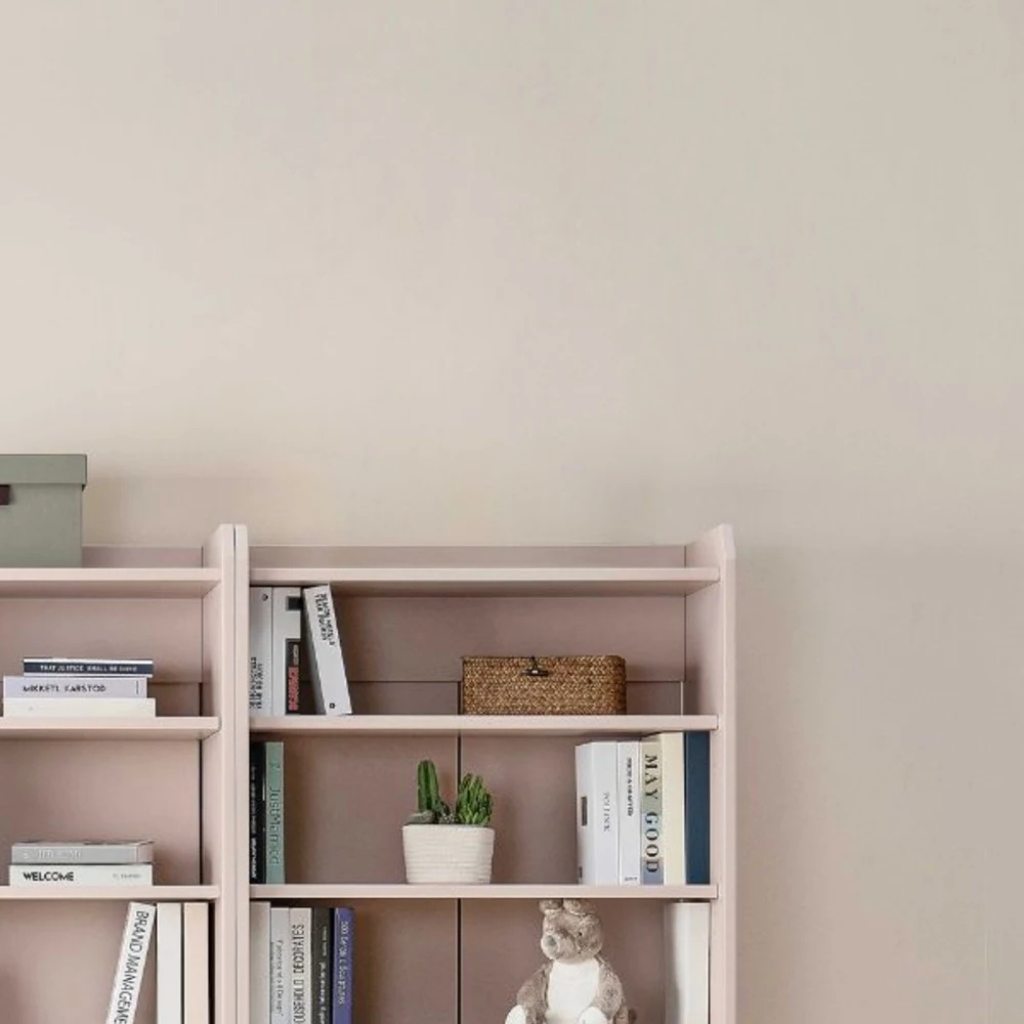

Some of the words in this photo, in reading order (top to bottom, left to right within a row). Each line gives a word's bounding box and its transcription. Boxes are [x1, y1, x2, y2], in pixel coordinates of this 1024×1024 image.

[644, 754, 658, 800] MAY
[644, 812, 659, 873] GOOD
[23, 871, 74, 881] WELCOME
[129, 910, 150, 953] BRAND
